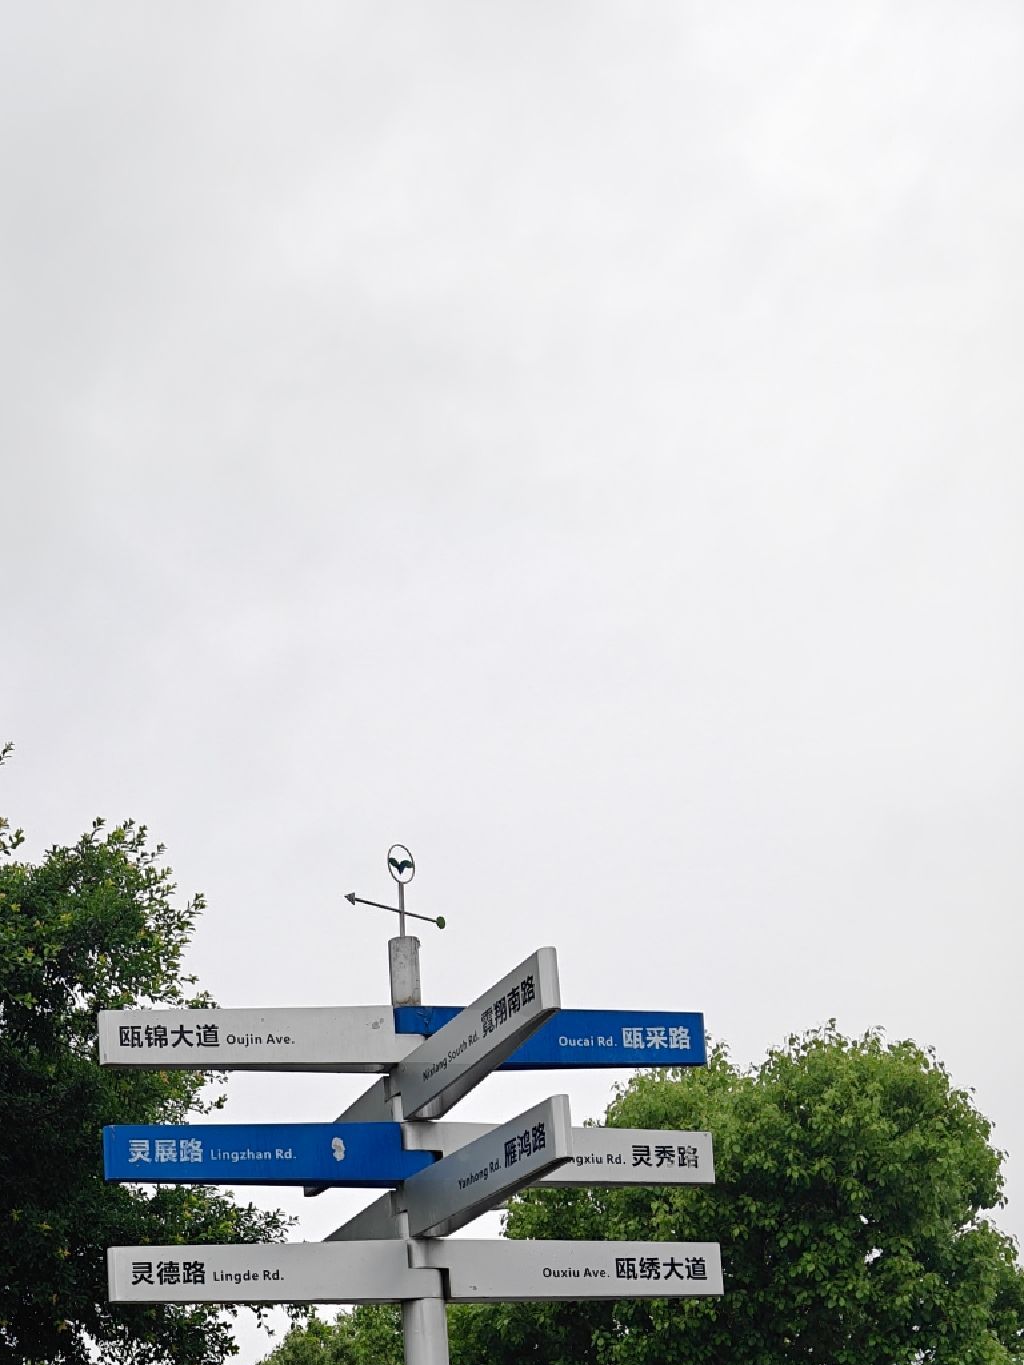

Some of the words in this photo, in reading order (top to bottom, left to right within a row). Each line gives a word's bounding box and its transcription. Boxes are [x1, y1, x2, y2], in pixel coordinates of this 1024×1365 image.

[119, 1024, 220, 1048] 瓯锦大道
[226, 1032, 262, 1047] Oujin
[266, 1033, 296, 1045] Ave.
[558, 1036, 594, 1047] Oucai
[597, 1036, 618, 1047] Rd.
[622, 1026, 691, 1050] 瓯采路
[447, 1040, 468, 1062] South
[128, 1138, 204, 1163] 灵展路
[210, 1149, 272, 1162] Lingzhan
[275, 1148, 297, 1160] Rd.
[504, 1121, 546, 1168] 雁鸿路
[489, 1158, 502, 1173] Rd.
[607, 1153, 626, 1165] Rd.
[631, 1144, 699, 1169] 灵秀路
[131, 1260, 206, 1286] 灵德路
[212, 1269, 260, 1285] Lingde
[263, 1269, 285, 1281] Rd.
[542, 1267, 580, 1278] Ouxiu
[583, 1267, 611, 1278] Ave.
[615, 1256, 708, 1281] 瓯绣大道
